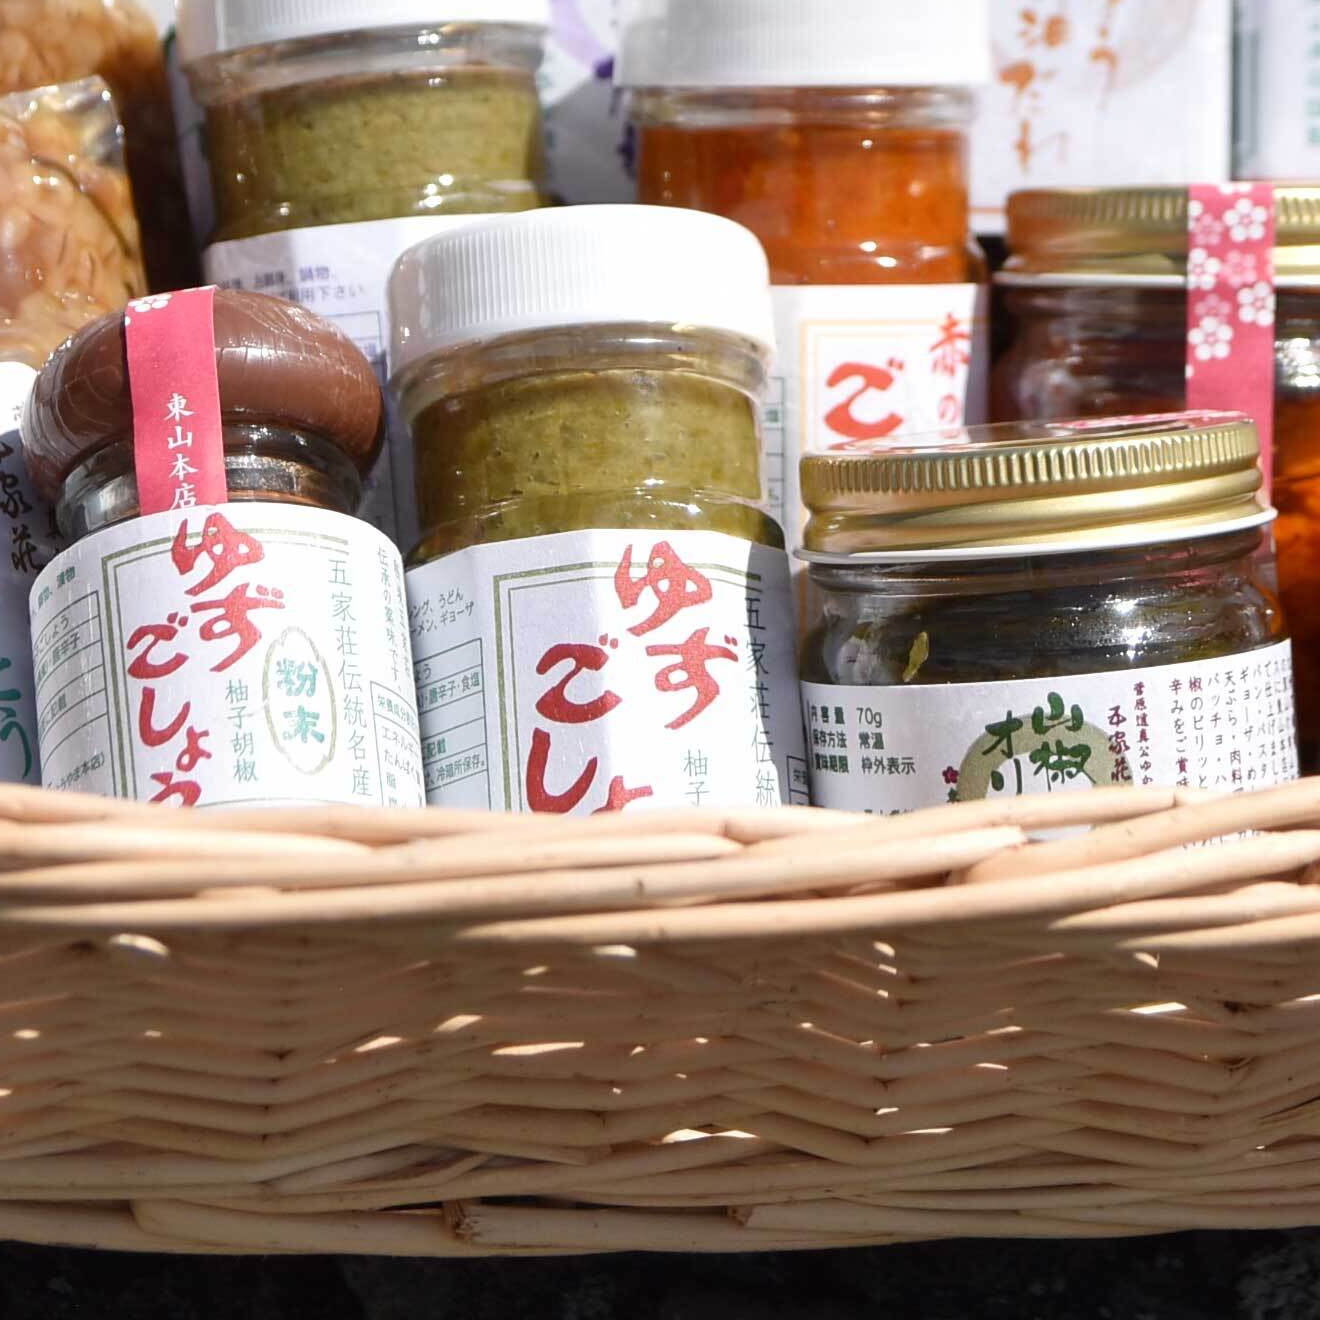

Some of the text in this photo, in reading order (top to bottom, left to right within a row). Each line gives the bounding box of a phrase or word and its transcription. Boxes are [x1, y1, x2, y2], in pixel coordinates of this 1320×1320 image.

[164, 392, 199, 511] 東山本店
[170, 511, 286, 673] ゆず
[613, 540, 740, 731] ゆず
[275, 656, 326, 745] 粉末
[327, 558, 373, 798] 五家荘伝統名産
[856, 707, 883, 729] 70g
[224, 679, 258, 783] 柚子胡椒
[861, 756, 917, 776] 枠外表示
[1029, 692, 1098, 792] 山椒
